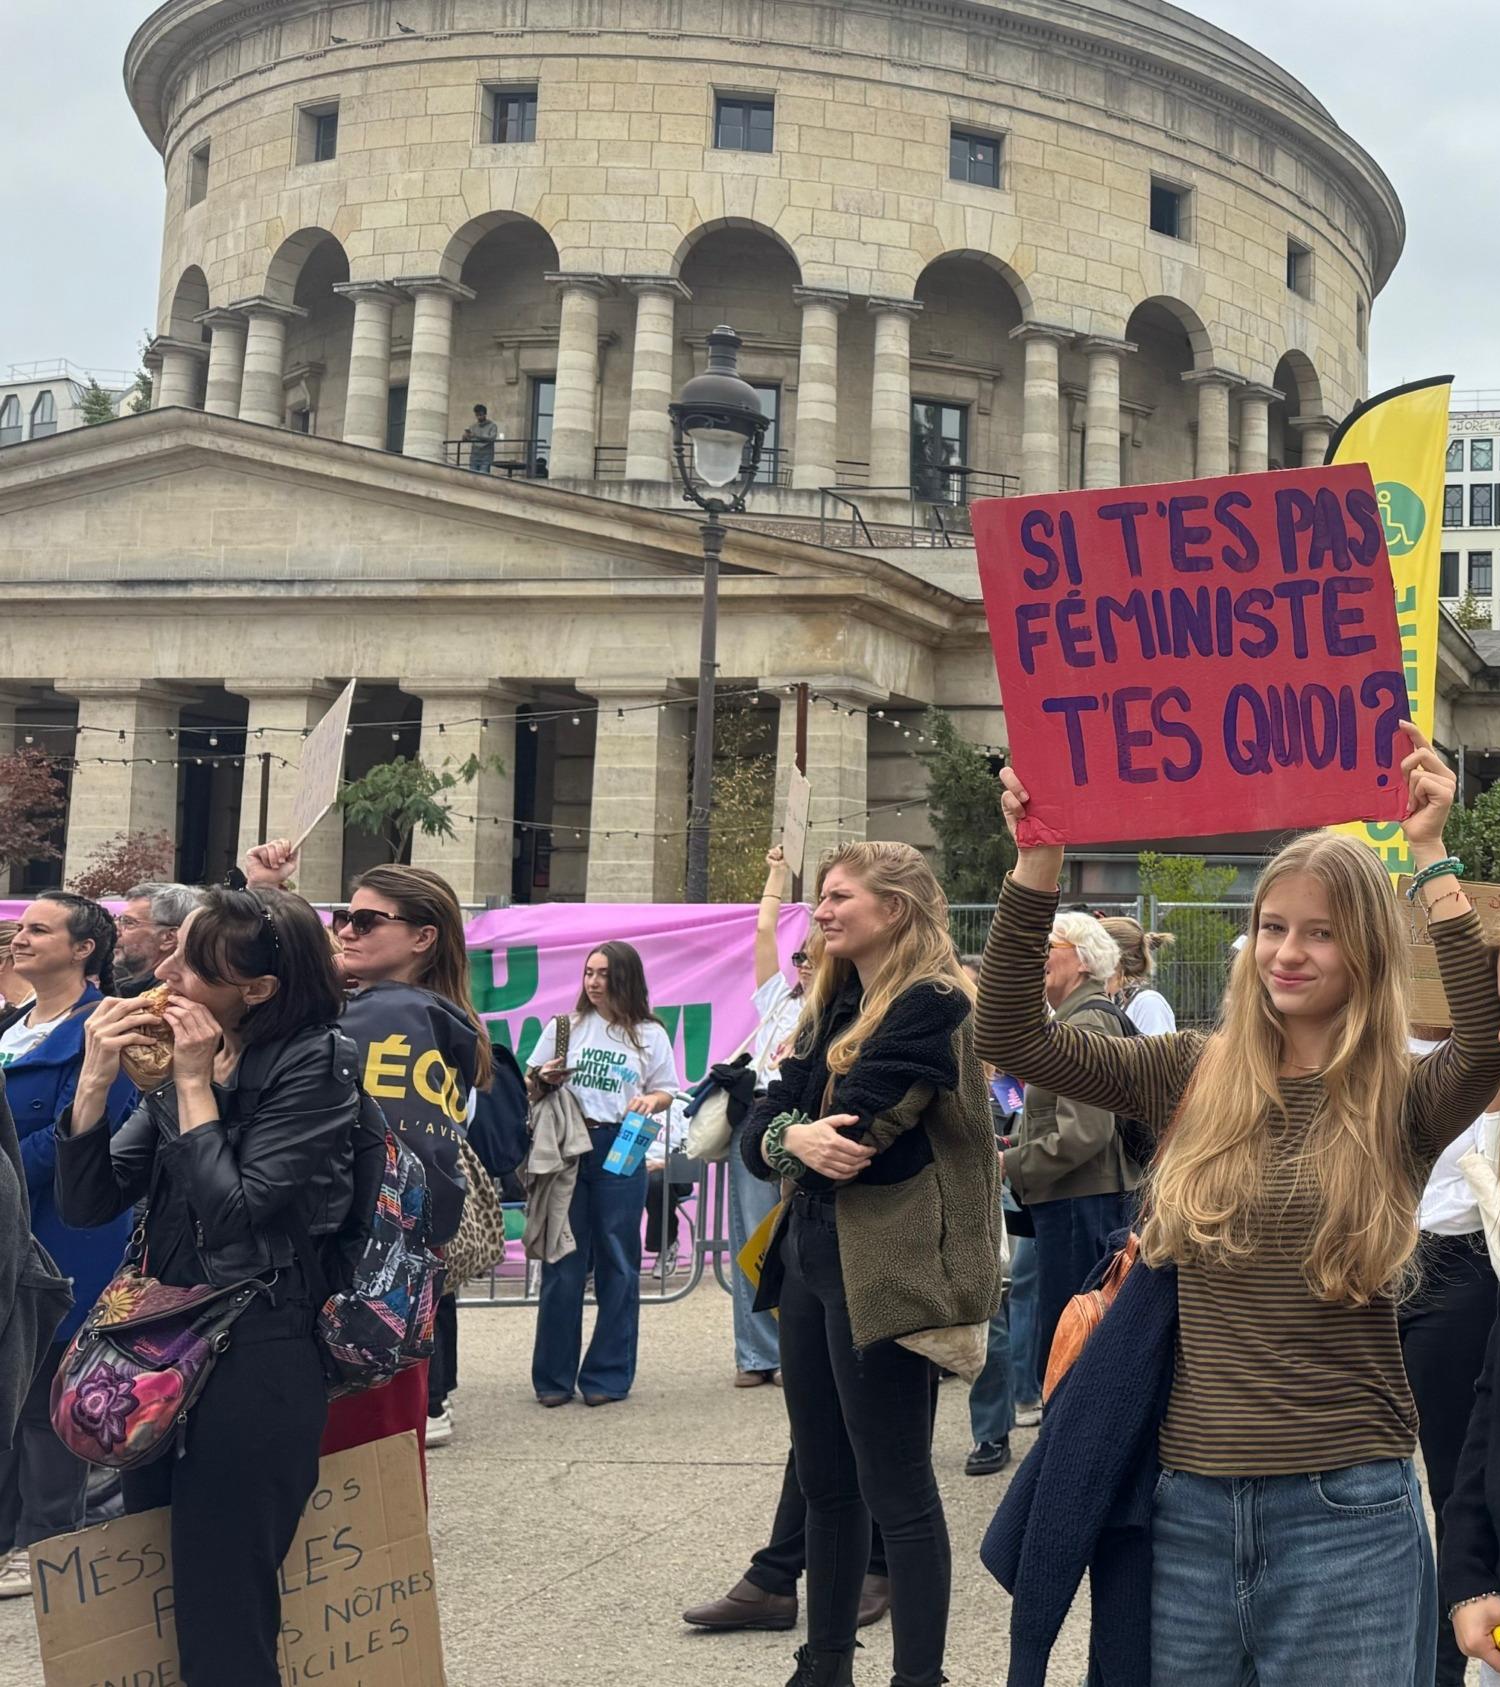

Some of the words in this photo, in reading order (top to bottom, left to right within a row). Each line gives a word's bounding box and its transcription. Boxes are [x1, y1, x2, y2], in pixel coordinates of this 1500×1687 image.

[1020, 509, 1083, 591] SI
[1098, 491, 1260, 577] T'ES
[1275, 487, 1383, 574] PAS
[1016, 577, 1377, 674] FÉMINISTE
[1042, 686, 1202, 786] T'ES
[1222, 670, 1411, 787] QUOI?
[363, 1034, 468, 1124] ÉQU
[572, 1073, 622, 1093] WOMEN!
[577, 1060, 609, 1076] WITH
[582, 1048, 627, 1065] WORLD
[37, 1543, 166, 1614] MESS
[278, 1525, 363, 1596] LES
[324, 1568, 434, 1632] NÔTRES
